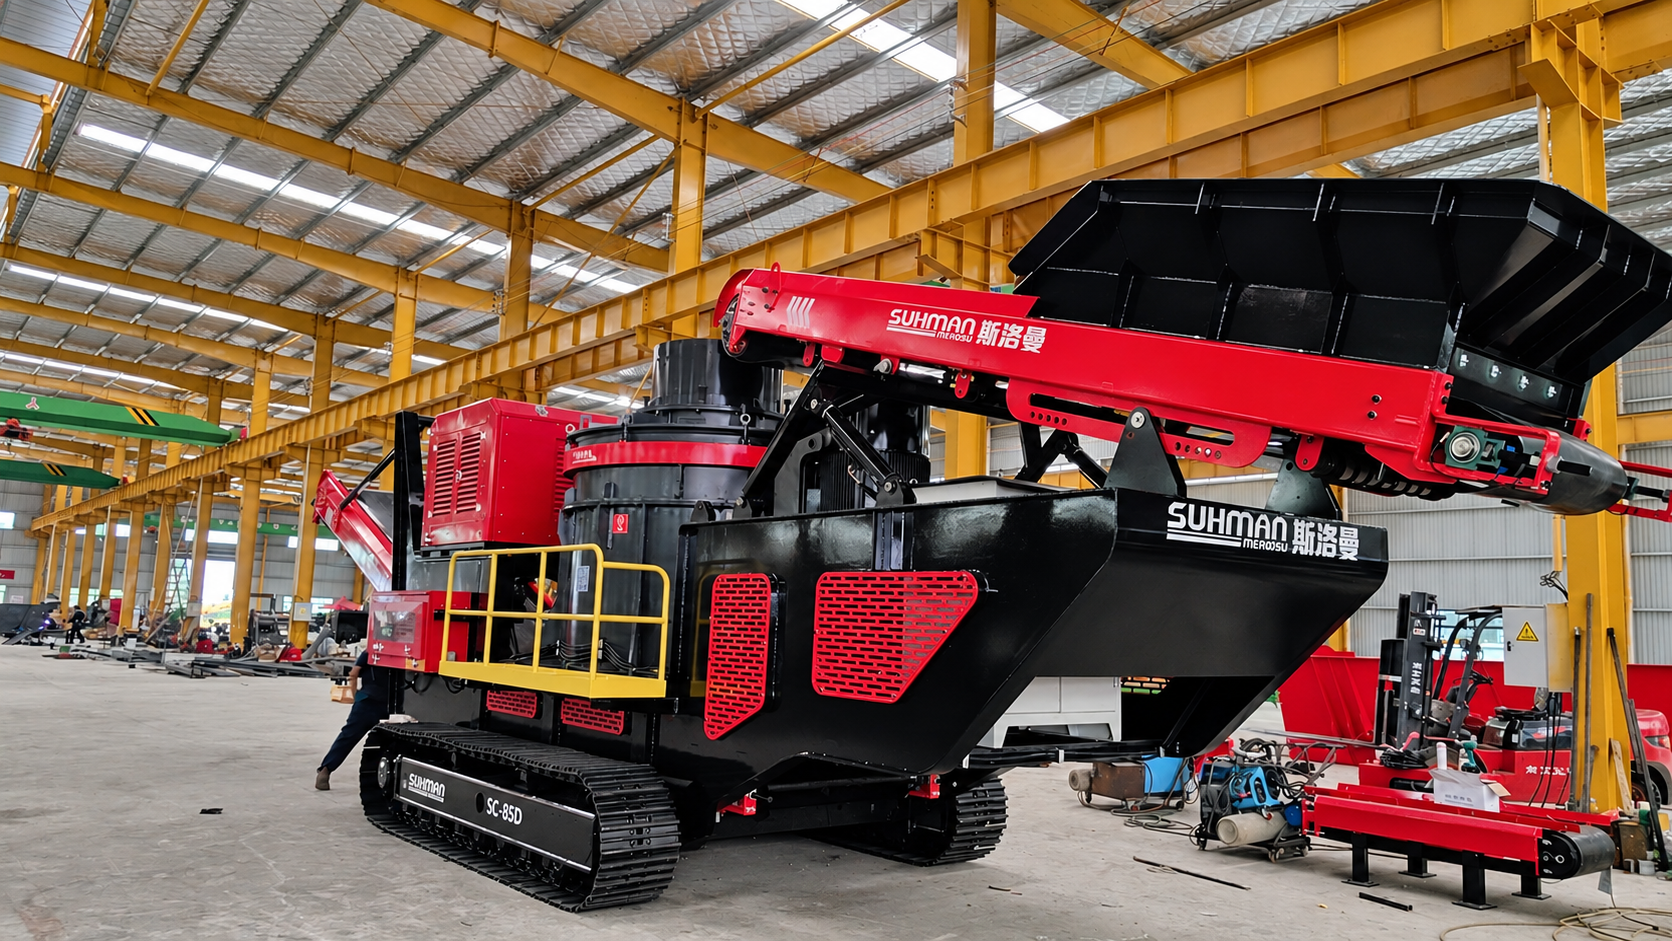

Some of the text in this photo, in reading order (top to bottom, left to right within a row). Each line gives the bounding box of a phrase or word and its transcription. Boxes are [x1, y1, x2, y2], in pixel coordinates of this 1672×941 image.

[888, 308, 976, 335] SUHMAN
[976, 319, 1047, 353] 斯洛曼
[1167, 501, 1288, 542] SUHMAN
[1292, 518, 1360, 561] 斯洛曼
[486, 797, 523, 825] SC-85D
